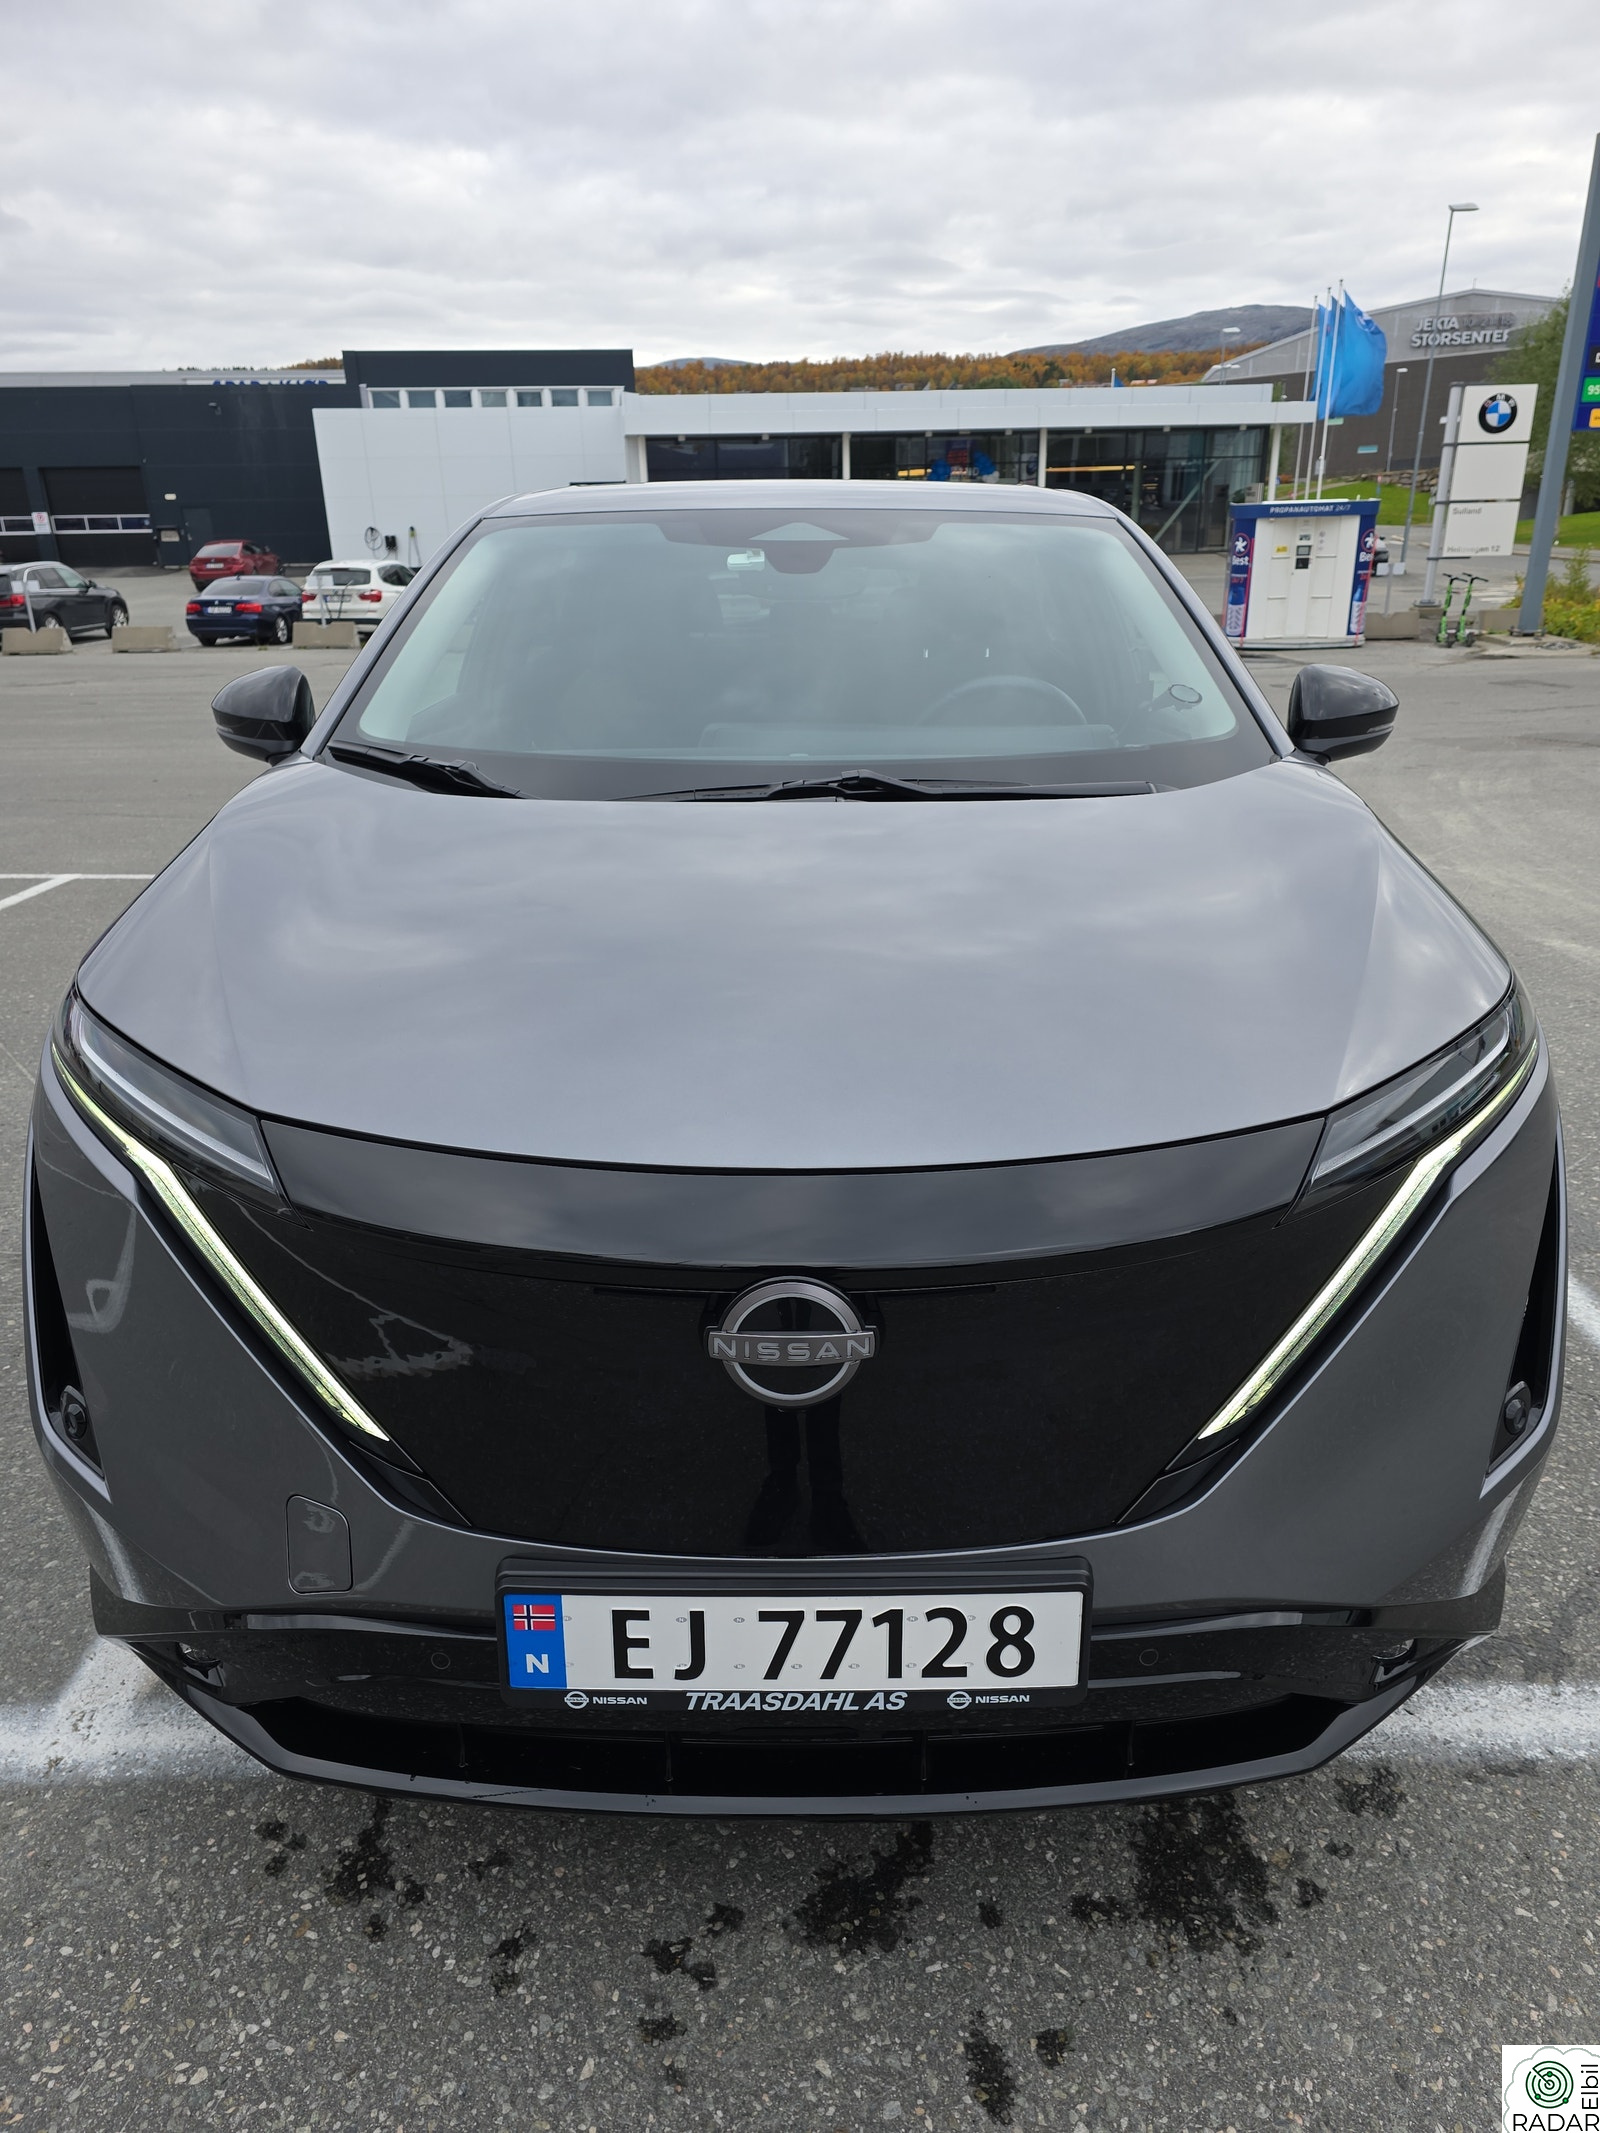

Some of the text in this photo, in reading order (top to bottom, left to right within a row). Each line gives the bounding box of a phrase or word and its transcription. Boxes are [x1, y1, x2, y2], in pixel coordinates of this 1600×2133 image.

[1416, 317, 1459, 331] JEKTA
[713, 1337, 870, 1362] NISSAN
[611, 1606, 1036, 1681] EJ 77128
[526, 1653, 549, 1674] N
[592, 1696, 648, 1705] NISSAN
[685, 1692, 908, 1711] TRAASDAHL AS
[975, 1695, 1030, 1704] NISSAN
